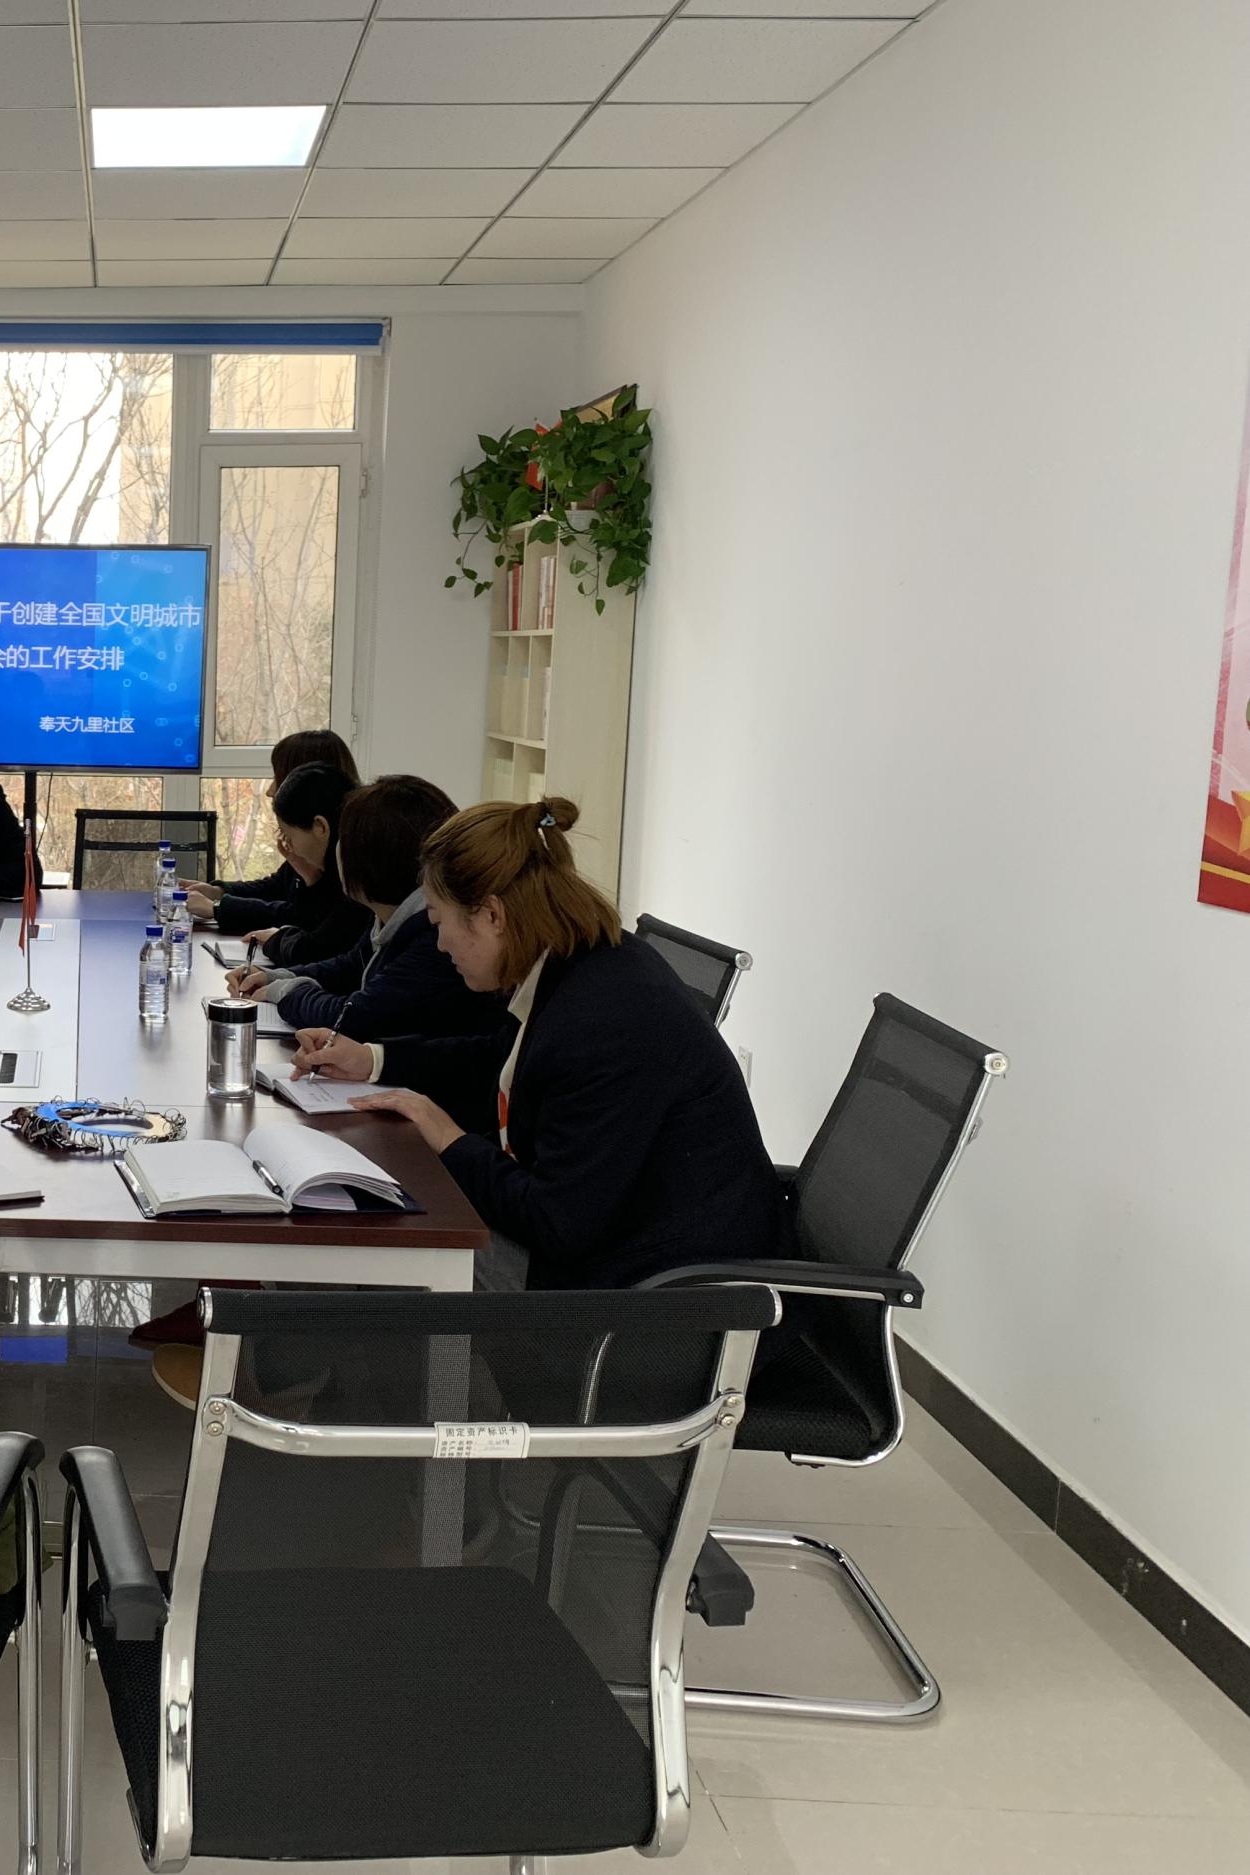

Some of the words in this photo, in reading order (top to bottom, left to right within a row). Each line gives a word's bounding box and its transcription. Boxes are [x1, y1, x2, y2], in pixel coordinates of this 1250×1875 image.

[38, 716, 135, 734] 奉天九里社区
[445, 1426, 518, 1438] 固定资产标识卡
